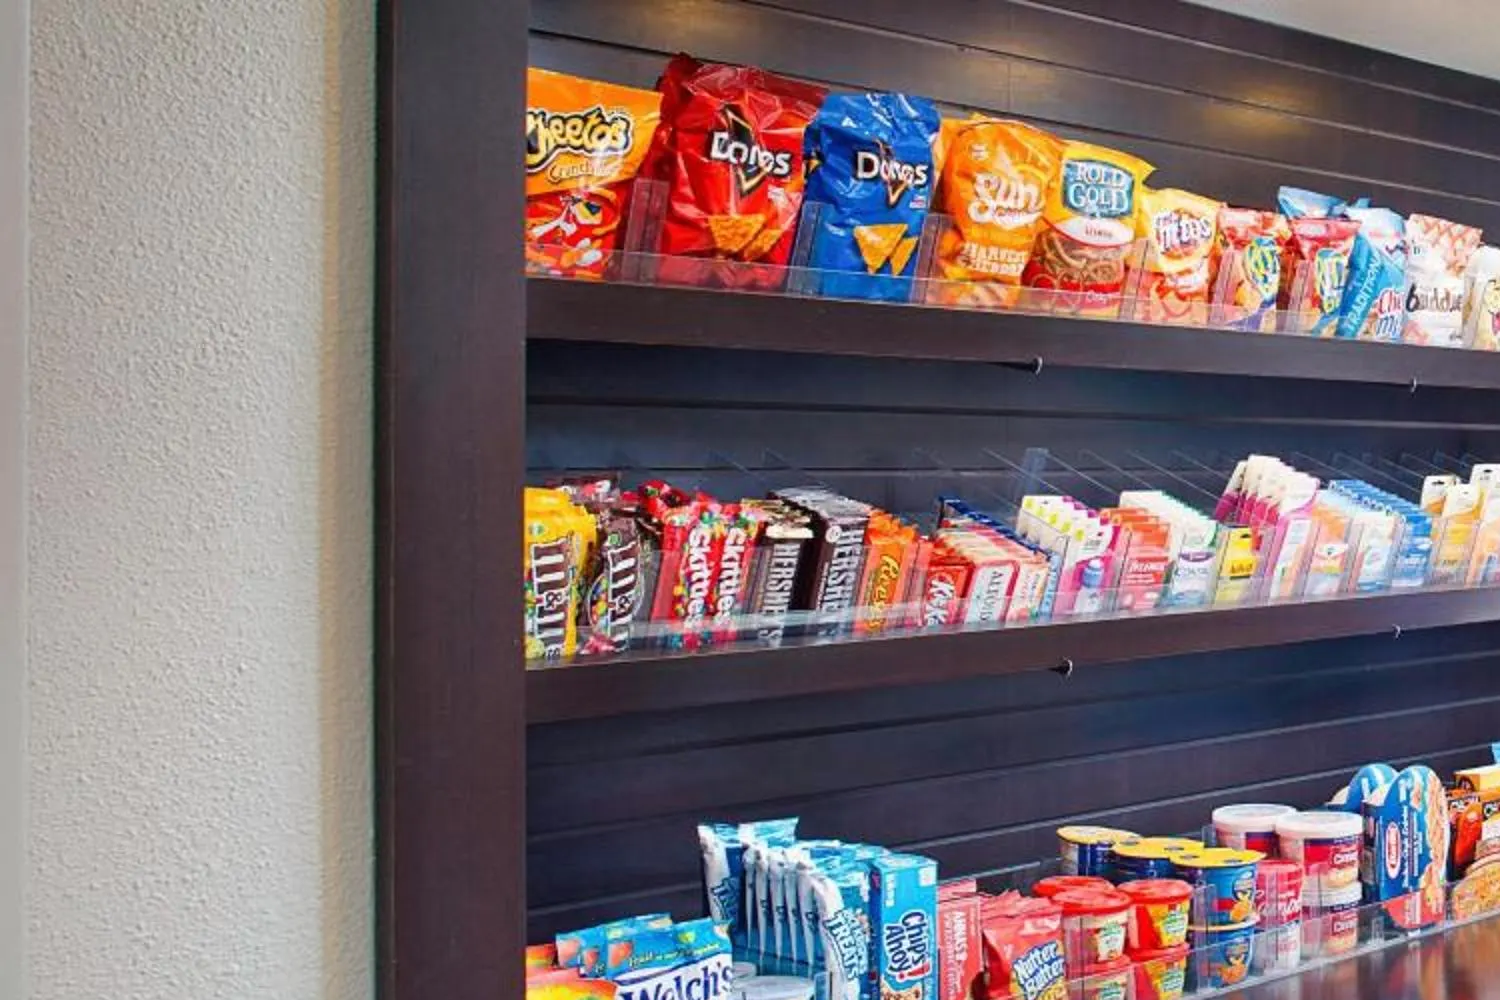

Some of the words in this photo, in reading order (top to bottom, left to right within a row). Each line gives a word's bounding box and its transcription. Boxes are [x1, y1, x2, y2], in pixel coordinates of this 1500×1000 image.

[1068, 182, 1131, 213] GOLD
[1078, 161, 1127, 186] ROLD
[684, 526, 712, 632] Skittles
[714, 526, 747, 628] Skittles
[824, 910, 860, 982] TREATS
[900, 910, 930, 967] Chips
